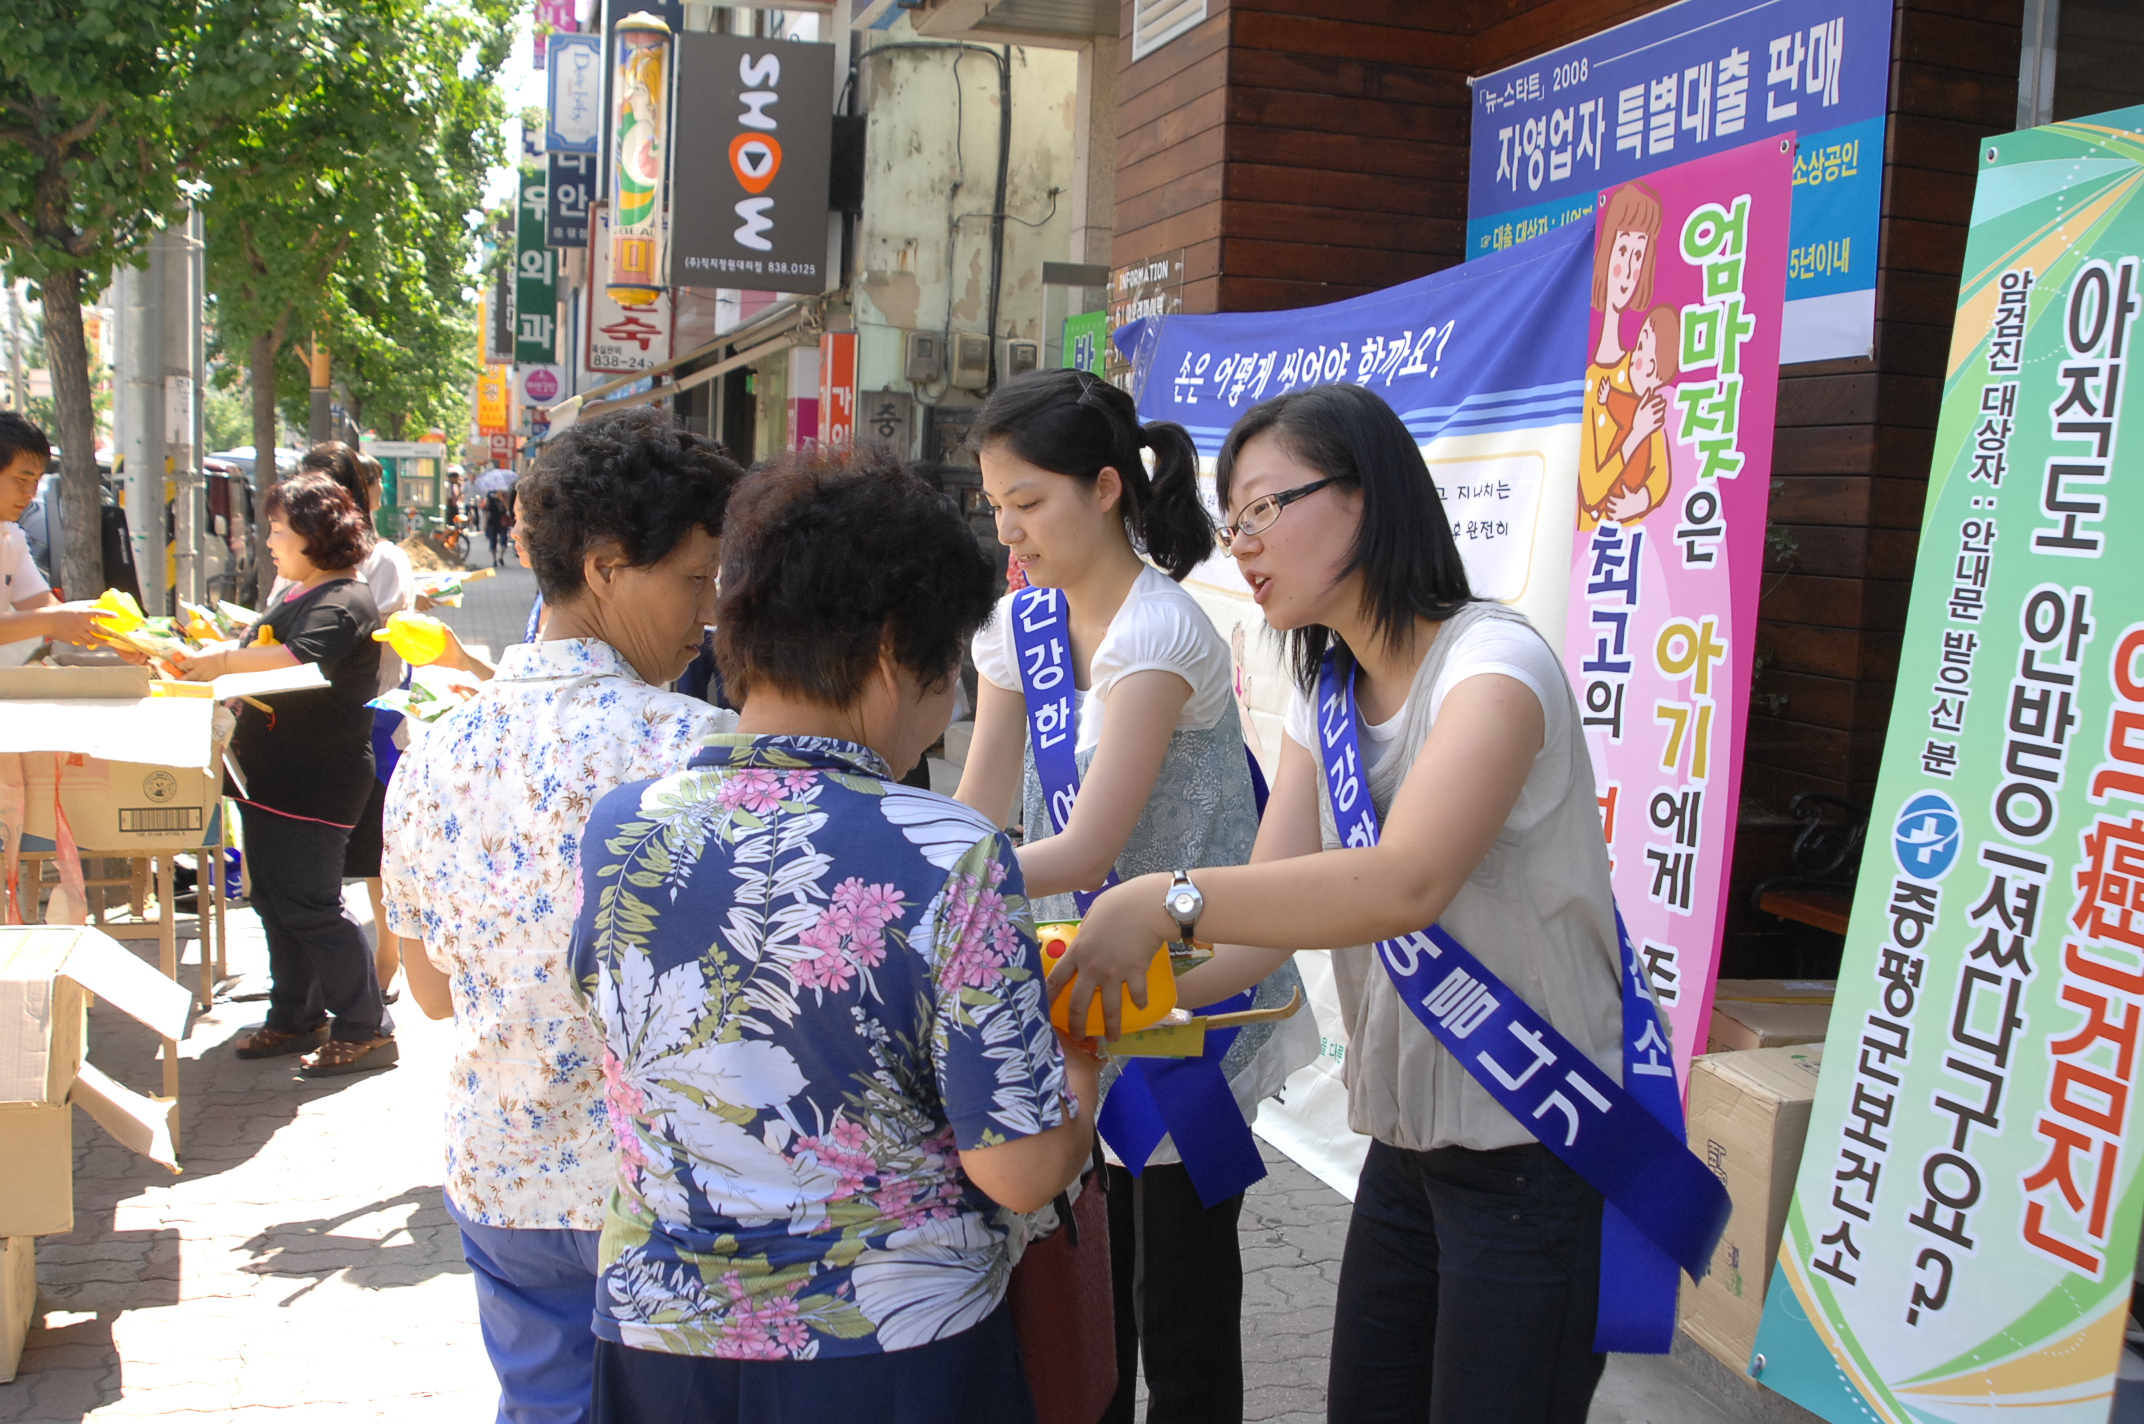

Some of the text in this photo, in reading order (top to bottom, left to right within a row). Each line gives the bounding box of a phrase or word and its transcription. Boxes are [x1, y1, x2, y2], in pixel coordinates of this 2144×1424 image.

[1496, 16, 1844, 192] 자영업자 특별대출 판매
[1553, 57, 1589, 92] 2008
[1791, 139, 1859, 186] 소상공인
[767, 261, 816, 274] 838.0125
[1119, 260, 1169, 291] INFORMATION
[1174, 351, 1211, 404] 손은
[1213, 350, 1277, 408] 어떻게
[1357, 319, 1455, 387] 할까요?
[1987, 270, 2034, 372] 암검진
[1676, 198, 1752, 564] 엄마젖은
[2032, 262, 2136, 552] 아직도
[1970, 382, 2018, 487] 대상자
[1458, 480, 1511, 500] 지나치는
[1466, 520, 1508, 540] 완전히
[1948, 519, 1997, 620] 안내문
[1019, 588, 1070, 750] 건강한
[1582, 525, 1643, 739] 최고의
[1929, 630, 1979, 734] 받으신
[1645, 619, 1725, 911] 아기에게
[1920, 739, 1958, 777] 분
